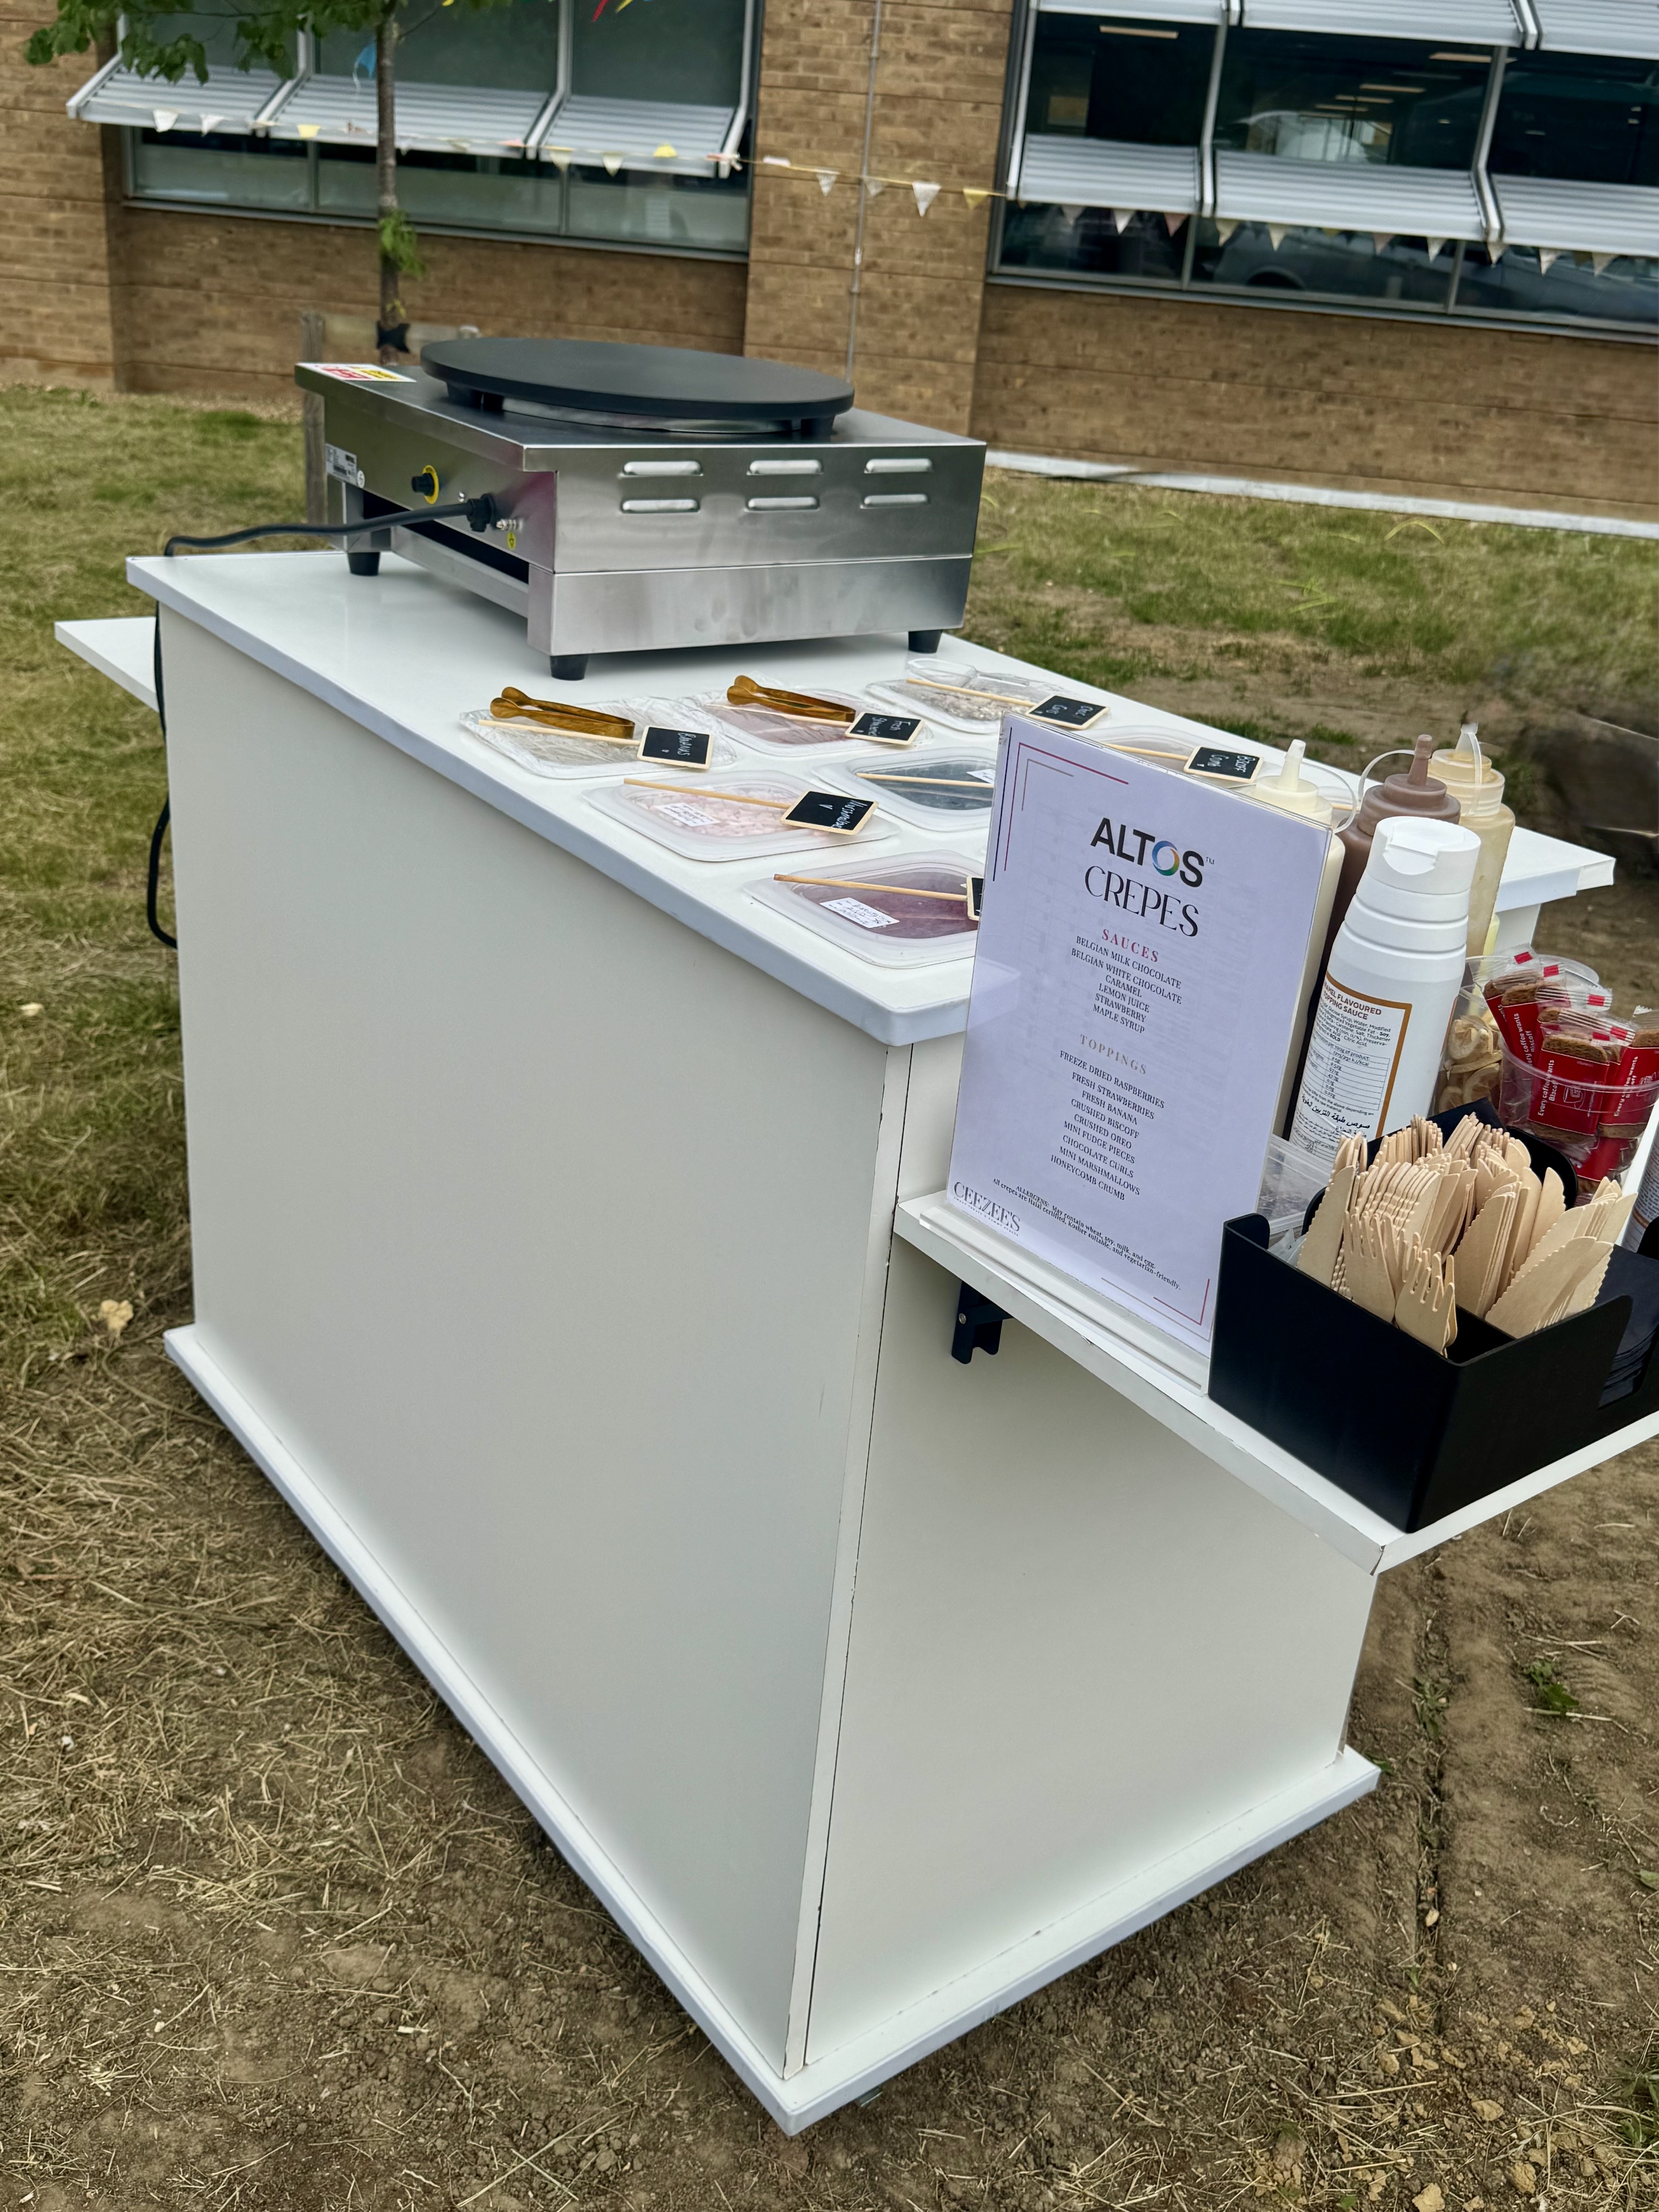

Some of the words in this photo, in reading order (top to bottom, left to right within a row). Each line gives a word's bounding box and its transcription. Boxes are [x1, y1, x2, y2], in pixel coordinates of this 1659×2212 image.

[1090, 817, 1204, 888] ALTOS
[1084, 865, 1199, 937] CREPES
[1076, 935, 1109, 956] BELGIAN
[1110, 950, 1130, 967] MILK
[1132, 960, 1182, 989] CHOCOLATE
[1101, 929, 1159, 962] SAUCES
[1071, 947, 1104, 969] BELGIAN
[1106, 963, 1131, 981] WHITE
[1132, 975, 1182, 1005] CHOCOLATE
[1105, 974, 1142, 998] CARAMEL
[1095, 993, 1146, 1023] STRAWBERRY
[1098, 982, 1127, 1002] LEMON
[1127, 996, 1150, 1013] JUICE
[1324, 991, 1342, 1009] TOPPING
[1343, 1006, 1368, 1020] SAUCE
[1337, 994, 1381, 1015] FLAVOURED
[1092, 1003, 1119, 1022] MAPLE
[1120, 1016, 1145, 1034] SYRUP
[1329, 1033, 1340, 1041] BOLD
[1369, 1024, 1391, 1032] Modified
[1514, 1013, 1523, 1032] wants
[1080, 1034, 1146, 1074] TOPPINGS
[1520, 1033, 1528, 1052] coffee
[1060, 1049, 1087, 1070] FREEZE
[1089, 1064, 1112, 1082] DRIED
[1113, 1077, 1164, 1108] RASPBERRIES
[1628, 1056, 1638, 1076] wants
[1072, 1071, 1096, 1090] FRESH
[1097, 1084, 1154, 1120] STRAWBERRIES
[1081, 1090, 1106, 1108] FRESH
[1107, 1103, 1137, 1125] BANANA
[1537, 1099, 1547, 1116] Every
[1071, 1098, 1106, 1121] CRUSHED
[1107, 1117, 1139, 1139] BISCOFF
[1074, 1113, 1109, 1137] CRUSHED
[1110, 1133, 1132, 1149] OREO
[1062, 1134, 1108, 1164] CHOCOLATE
[1109, 1159, 1133, 1178] CURLS
[1063, 1120, 1080, 1135] MINI
[1082, 1130, 1108, 1149] FUDGE
[1108, 1144, 1135, 1164] PIECES
[1051, 1154, 1096, 1185] HONEYCOMB
[1098, 1180, 1125, 1200] CRUMB
[1059, 1146, 1076, 1161] MINI
[1077, 1156, 1140, 1195] MARSHMALLOWS
[954, 1182, 1020, 1231] CEEZEE'S
[1016, 1185, 1049, 1208] ALLERGENS:
[1052, 1205, 1063, 1216] May
[1064, 1212, 1084, 1228] contain
[1085, 1224, 1103, 1239] wheat,
[1132, 1251, 1143, 1261] and
[1001, 1183, 1017, 1197] crepes
[1018, 1193, 1027, 1201] are
[1028, 1197, 1042, 1210] Halal
[1068, 1219, 1087, 1236] Kosher
[1112, 1245, 1123, 1256] and
[1123, 1252, 1182, 1291] vegetarian-friendly.
